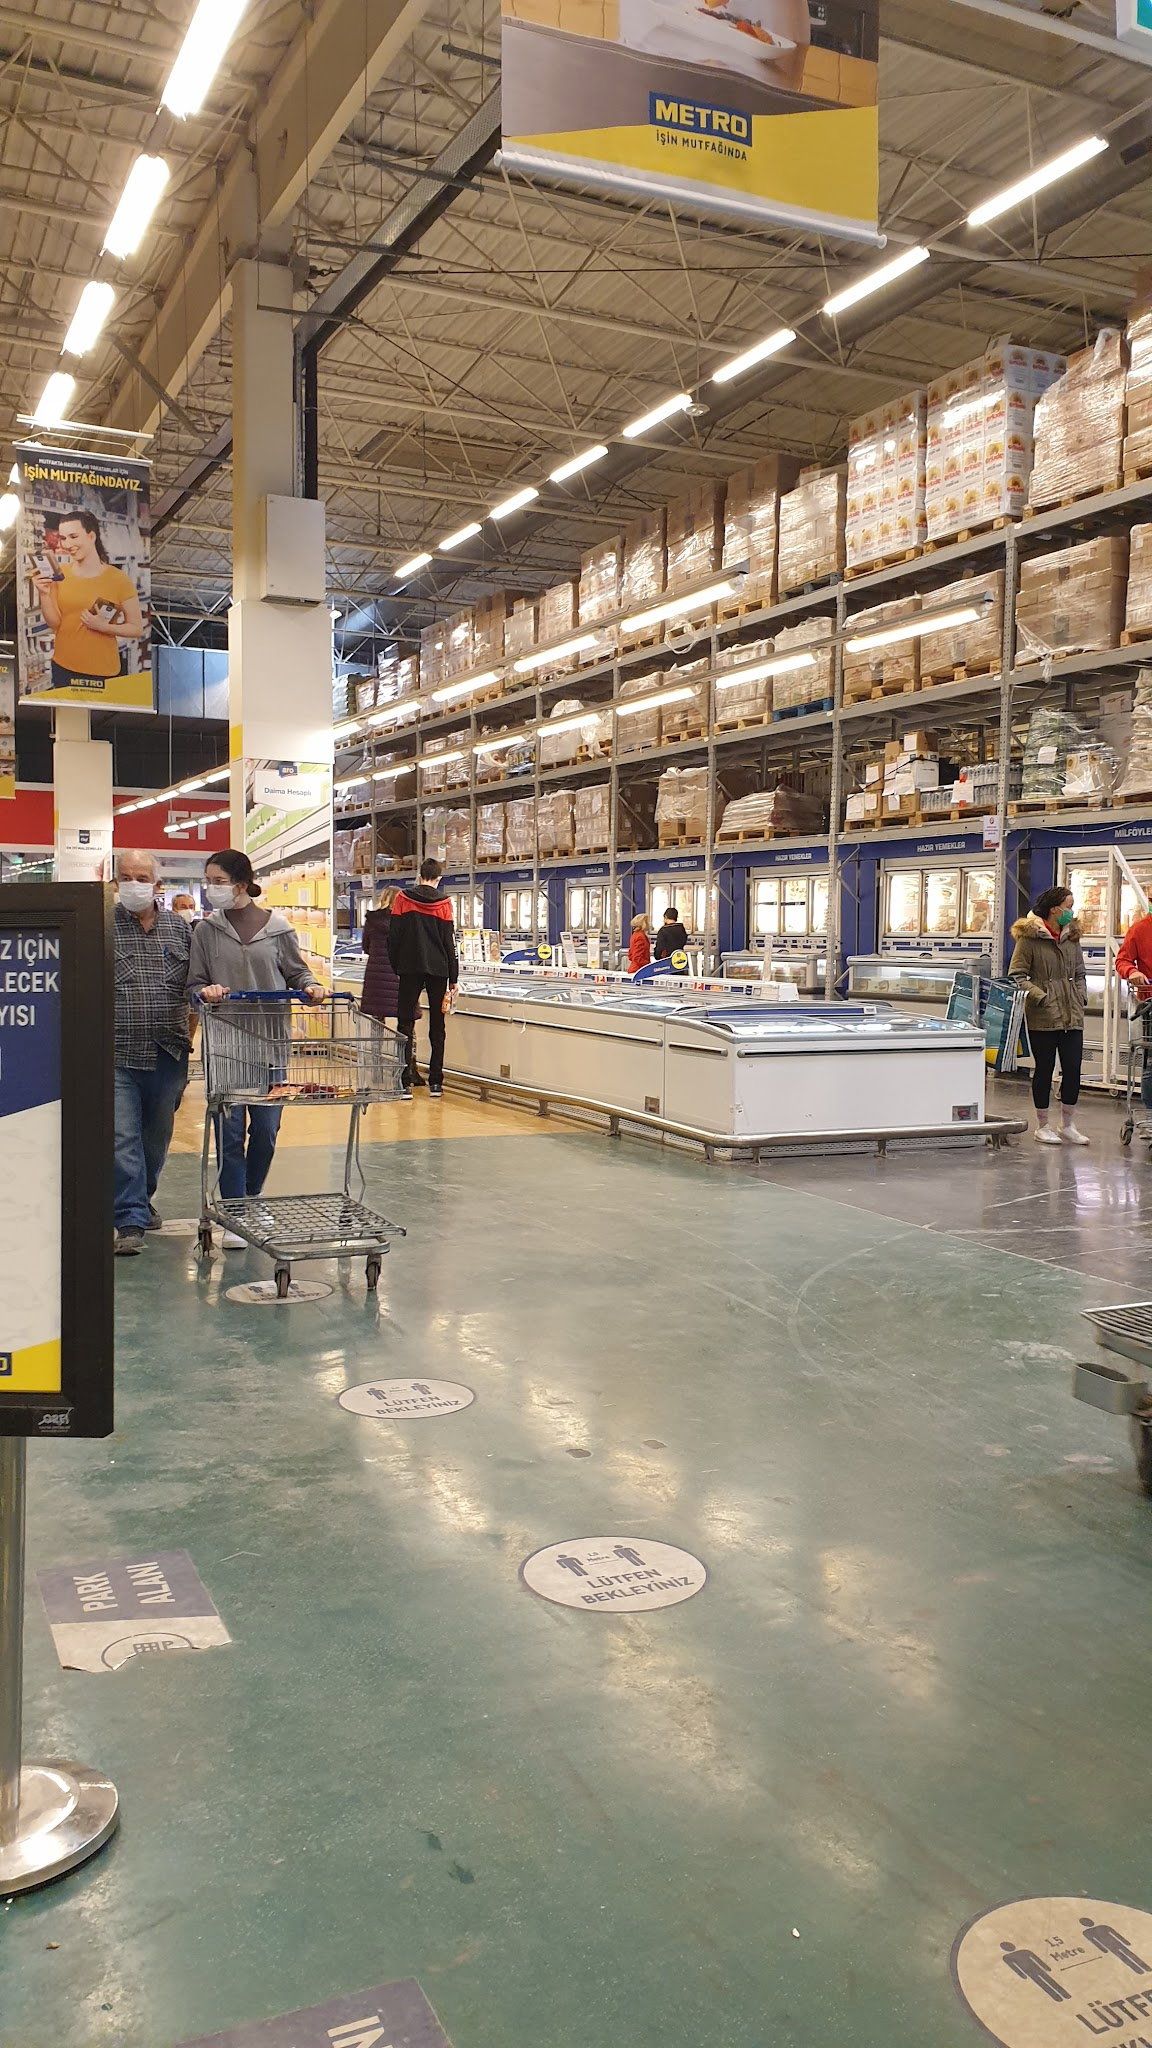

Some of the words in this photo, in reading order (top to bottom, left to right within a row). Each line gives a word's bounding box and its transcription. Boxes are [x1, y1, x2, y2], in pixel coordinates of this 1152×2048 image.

[655, 99, 748, 138] METRO
[656, 129, 678, 146] İŞİN
[682, 137, 747, 161] MUTFAĞINDA
[23, 463, 49, 482] İŞİN
[70, 679, 104, 688] METRO
[264, 787, 286, 796] Daima
[287, 789, 312, 798] Hesaplı
[917, 844, 934, 852] HAZIR
[935, 841, 966, 851] YEMEKLER
[17, 933, 60, 967] İÇİN
[376, 1400, 462, 1415] BEKLEYİNİZ
[384, 1396, 440, 1407] LÜTFEN
[125, 1561, 176, 1604] ALANI
[586, 1569, 662, 1589] LÜTFEN
[72, 1571, 118, 1612] PARK
[580, 1576, 695, 1604] BEKLEYİNİZ
[1050, 1947, 1085, 1961] Metre
